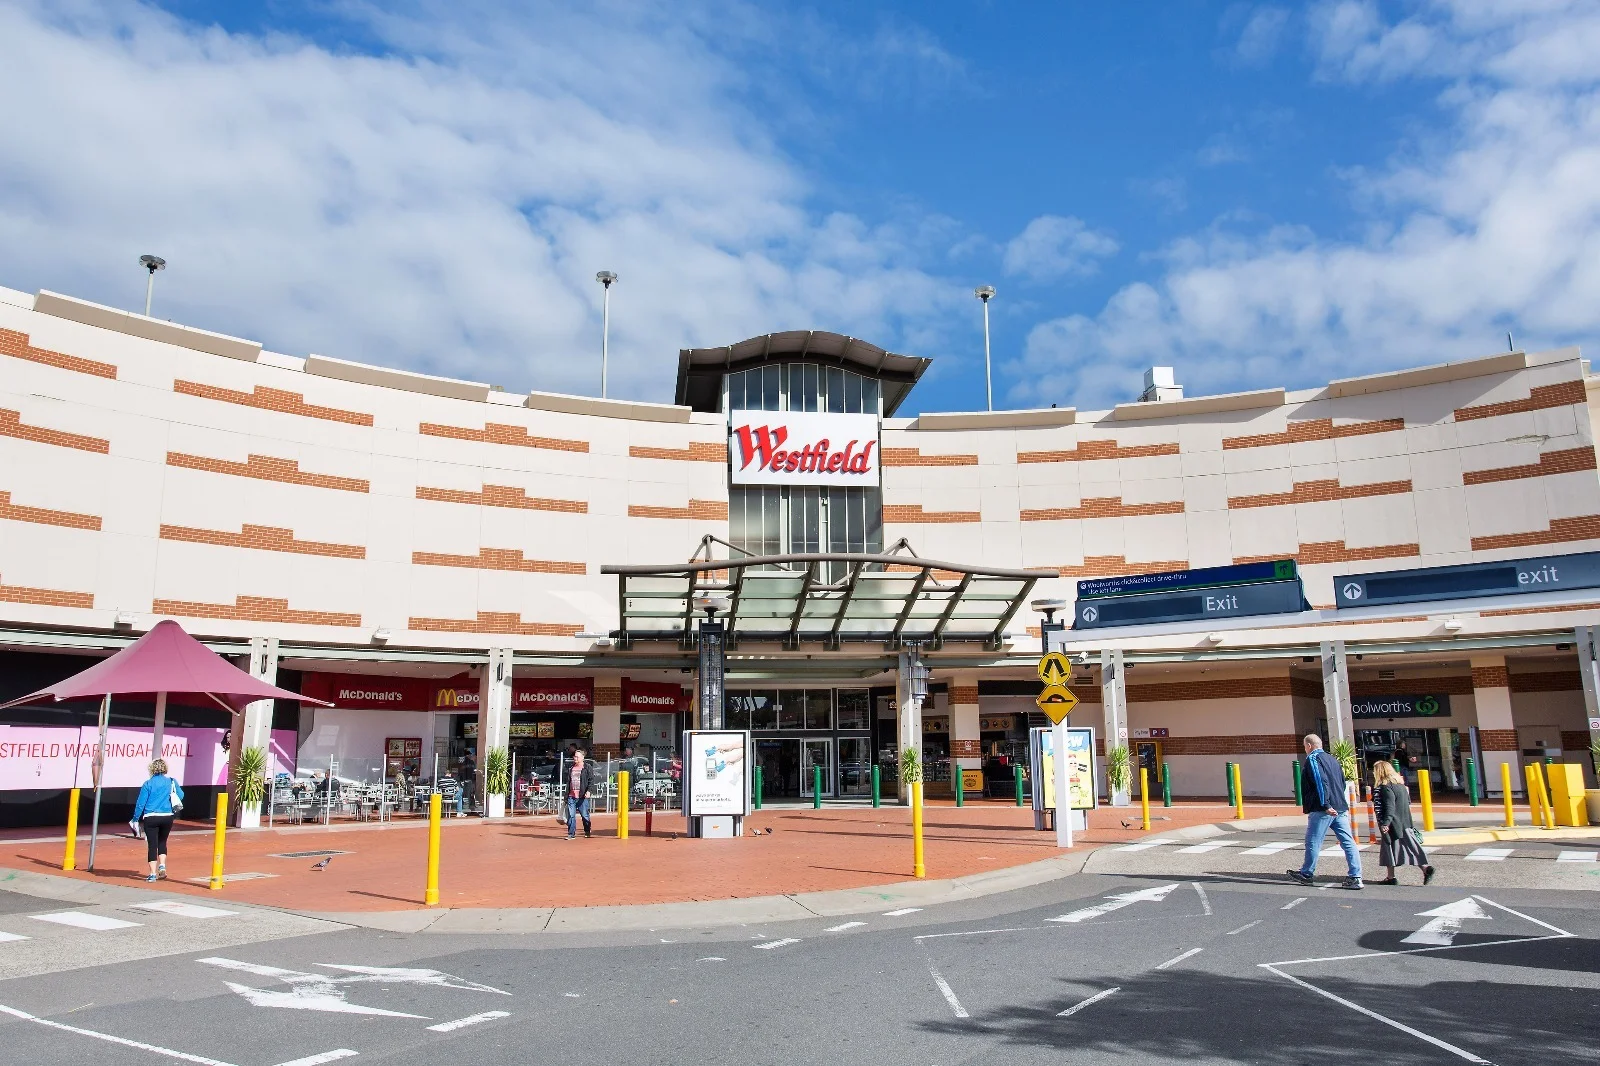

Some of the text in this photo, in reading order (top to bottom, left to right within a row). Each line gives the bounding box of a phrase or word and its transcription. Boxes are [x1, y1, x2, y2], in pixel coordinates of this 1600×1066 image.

[733, 424, 877, 474] Westfield
[1517, 565, 1559, 584] exit
[1206, 594, 1239, 611] Exit
[338, 689, 403, 701] McDonald's
[519, 692, 587, 702] McDonald's
[630, 694, 675, 705] McDonald's
[1352, 700, 1412, 714] oolworths
